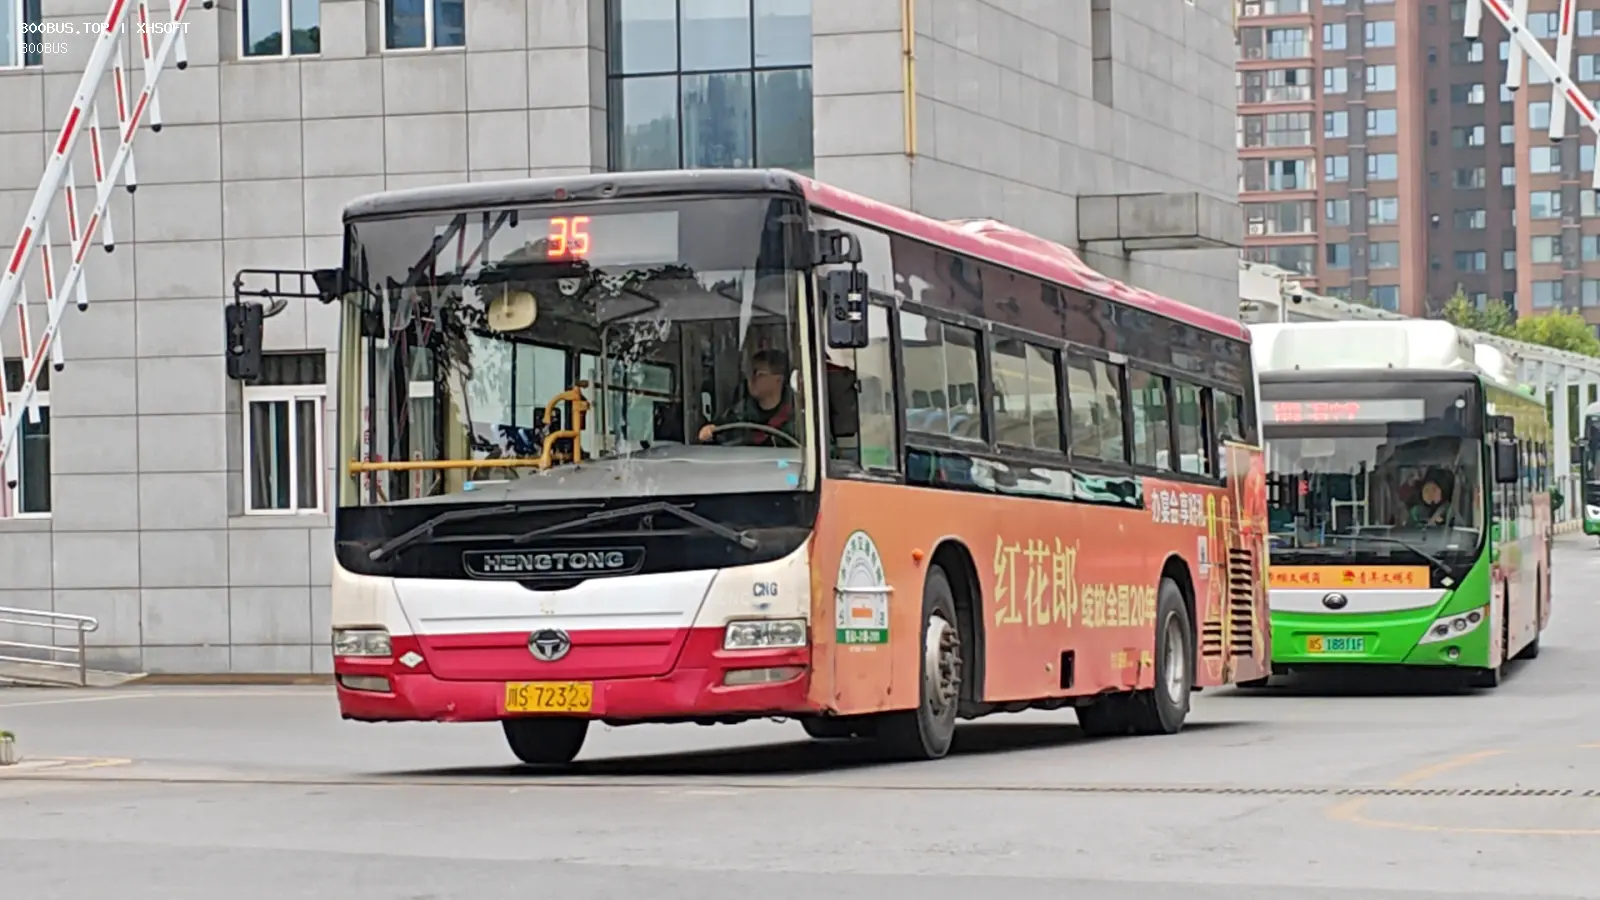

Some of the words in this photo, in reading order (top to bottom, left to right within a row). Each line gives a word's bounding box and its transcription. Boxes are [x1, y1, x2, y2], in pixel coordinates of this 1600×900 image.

[548, 215, 591, 257] 35
[483, 551, 624, 572] HENGTONG
[753, 581, 778, 597] CNG
[993, 535, 1077, 628] 红花郎
